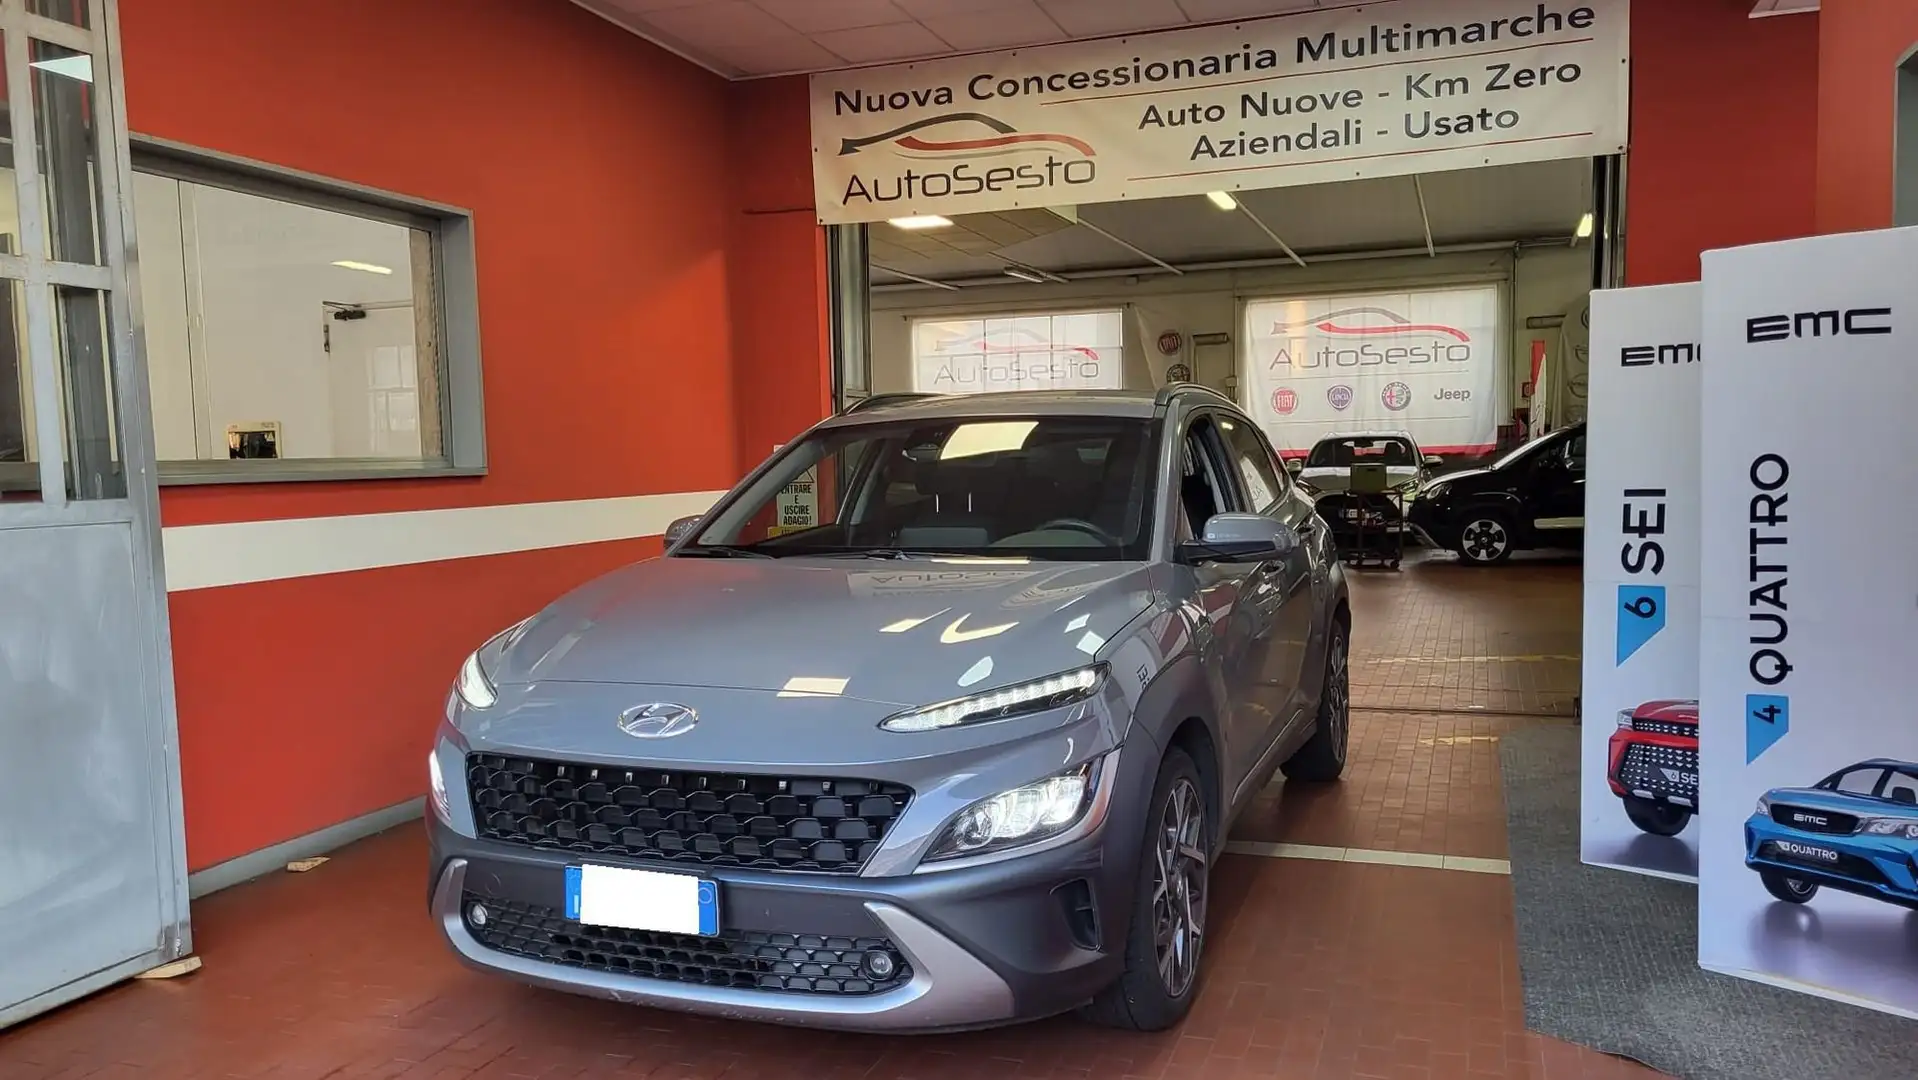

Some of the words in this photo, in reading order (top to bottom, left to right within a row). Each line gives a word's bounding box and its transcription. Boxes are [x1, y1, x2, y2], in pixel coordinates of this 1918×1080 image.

[834, 85, 953, 116] Nuova
[967, 43, 1277, 101] Concessionaria
[1296, 3, 1595, 64] Multimarche
[1138, 100, 1226, 130] Auto
[1240, 88, 1364, 119] Nuove
[1405, 72, 1469, 101] Km
[1485, 62, 1582, 92] Zero
[1190, 118, 1362, 161] Aziendali
[1404, 107, 1520, 139] Usato
[842, 155, 1096, 206] AutoSesto
[1269, 341, 1471, 370] AutoSesto
[1621, 343, 1701, 367] EM
[934, 358, 1100, 385] AutoSesto
[1433, 388, 1471, 402] Jeep
[784, 505, 810, 515] USCIRE
[794, 494, 799, 504] E
[783, 515, 812, 526] ADAGIO!
[1621, 488, 1667, 576] SEI
[1749, 453, 1793, 686] QUATTRO
[1623, 596, 1657, 619] 6
[1753, 704, 1781, 724] 4
[1680, 772, 1698, 785] SE
[1790, 843, 1838, 860] QUATTRO
